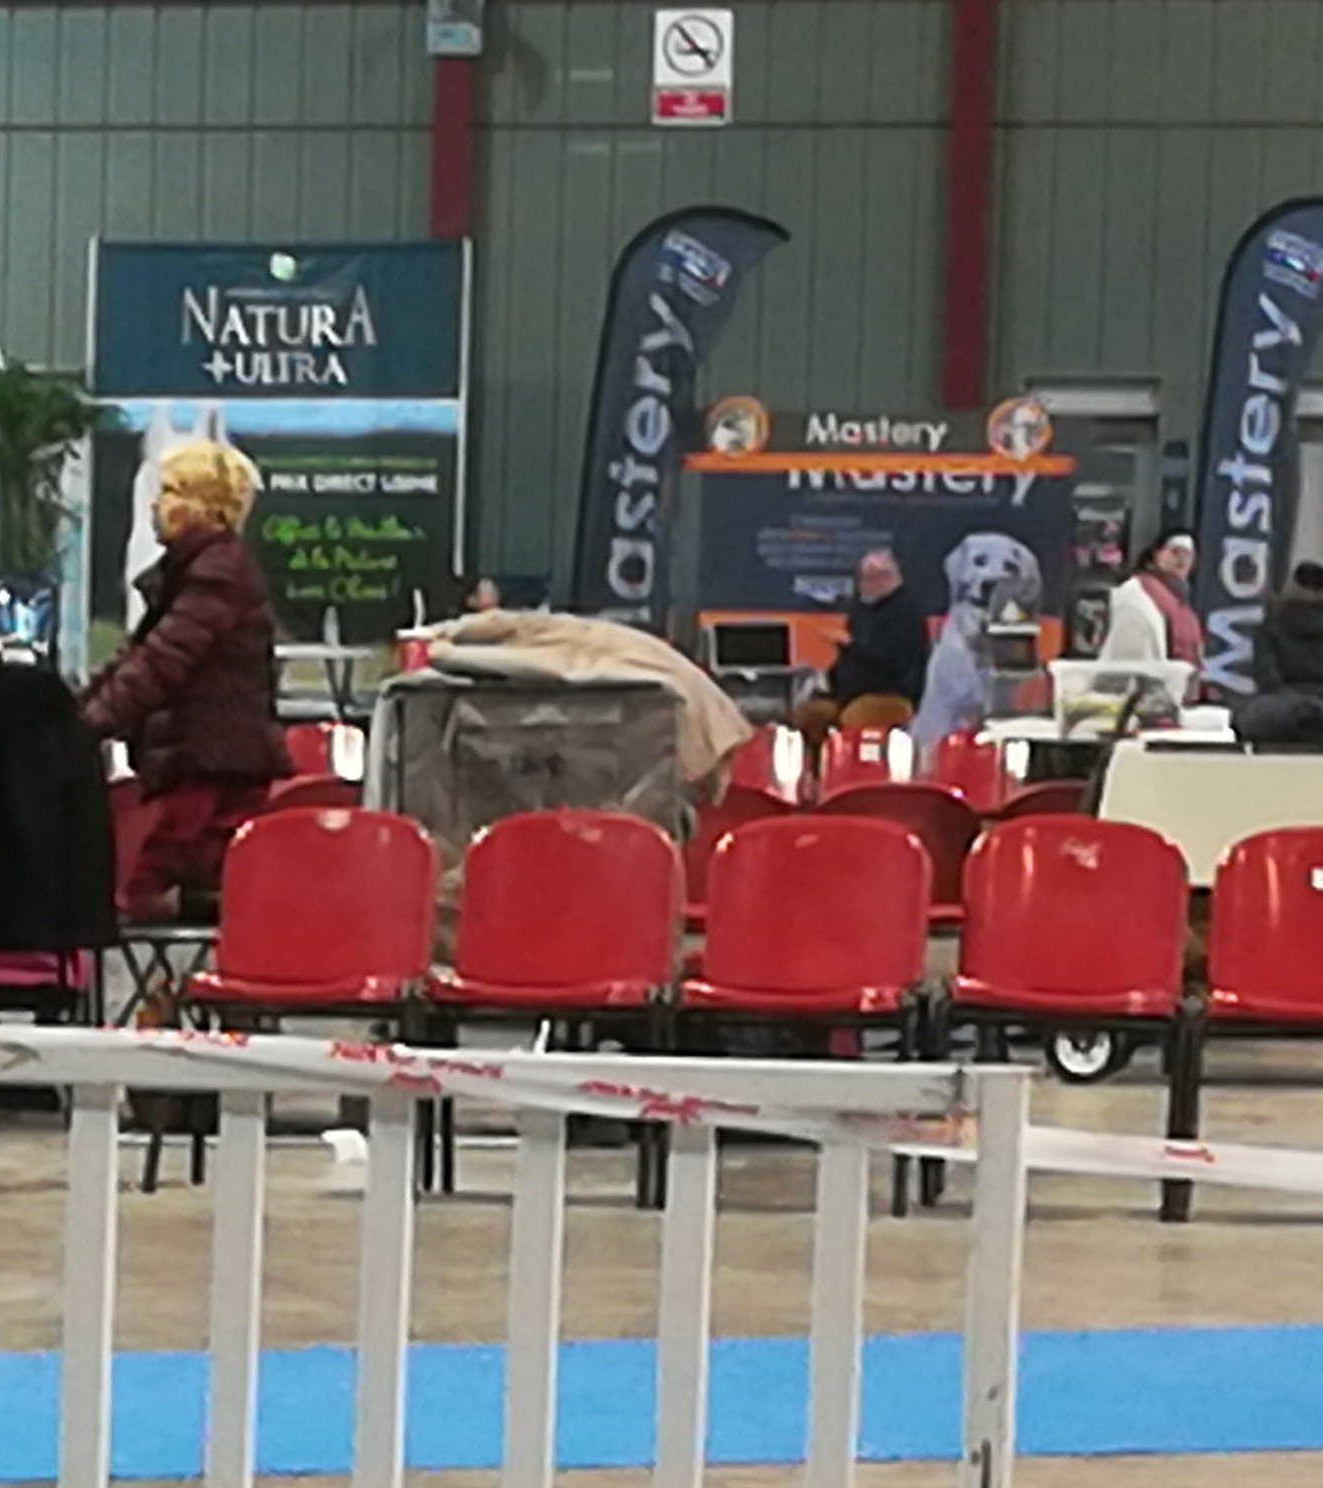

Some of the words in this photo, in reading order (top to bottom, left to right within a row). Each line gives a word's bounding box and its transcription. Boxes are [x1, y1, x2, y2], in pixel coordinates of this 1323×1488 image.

[180, 284, 379, 347] NATURA
[805, 412, 949, 452] Mastery
[1204, 291, 1304, 696] Mastery
